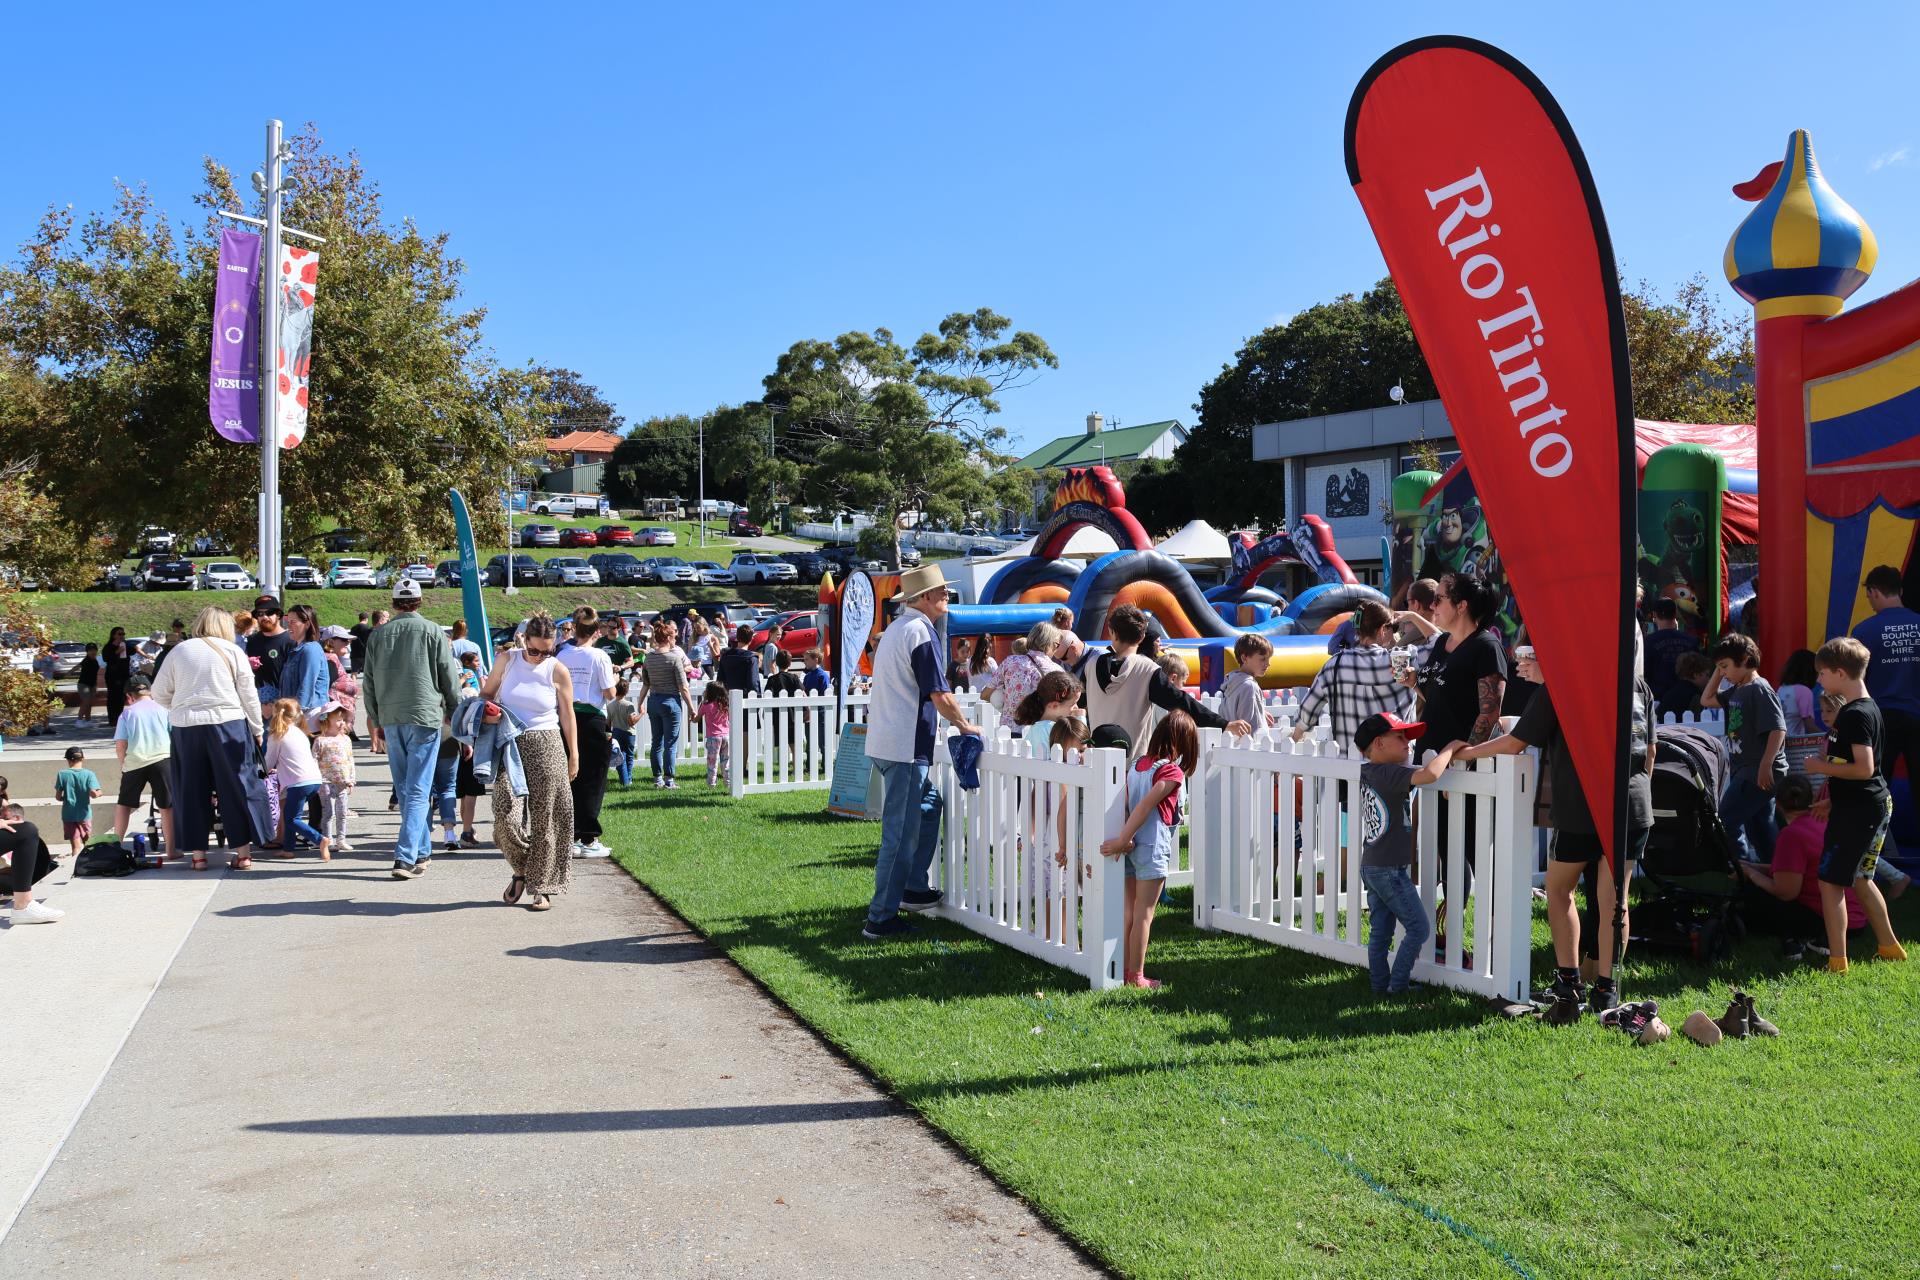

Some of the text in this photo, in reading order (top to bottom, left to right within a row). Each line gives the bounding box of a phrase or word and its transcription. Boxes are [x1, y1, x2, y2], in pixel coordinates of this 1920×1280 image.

[1425, 166, 1573, 477] Rio Tinto
[214, 378, 253, 390] JESUS
[1884, 624, 1918, 632] PERTH
[1883, 639, 1920, 648] CASTLE
[1891, 646, 1914, 654] HIRE
